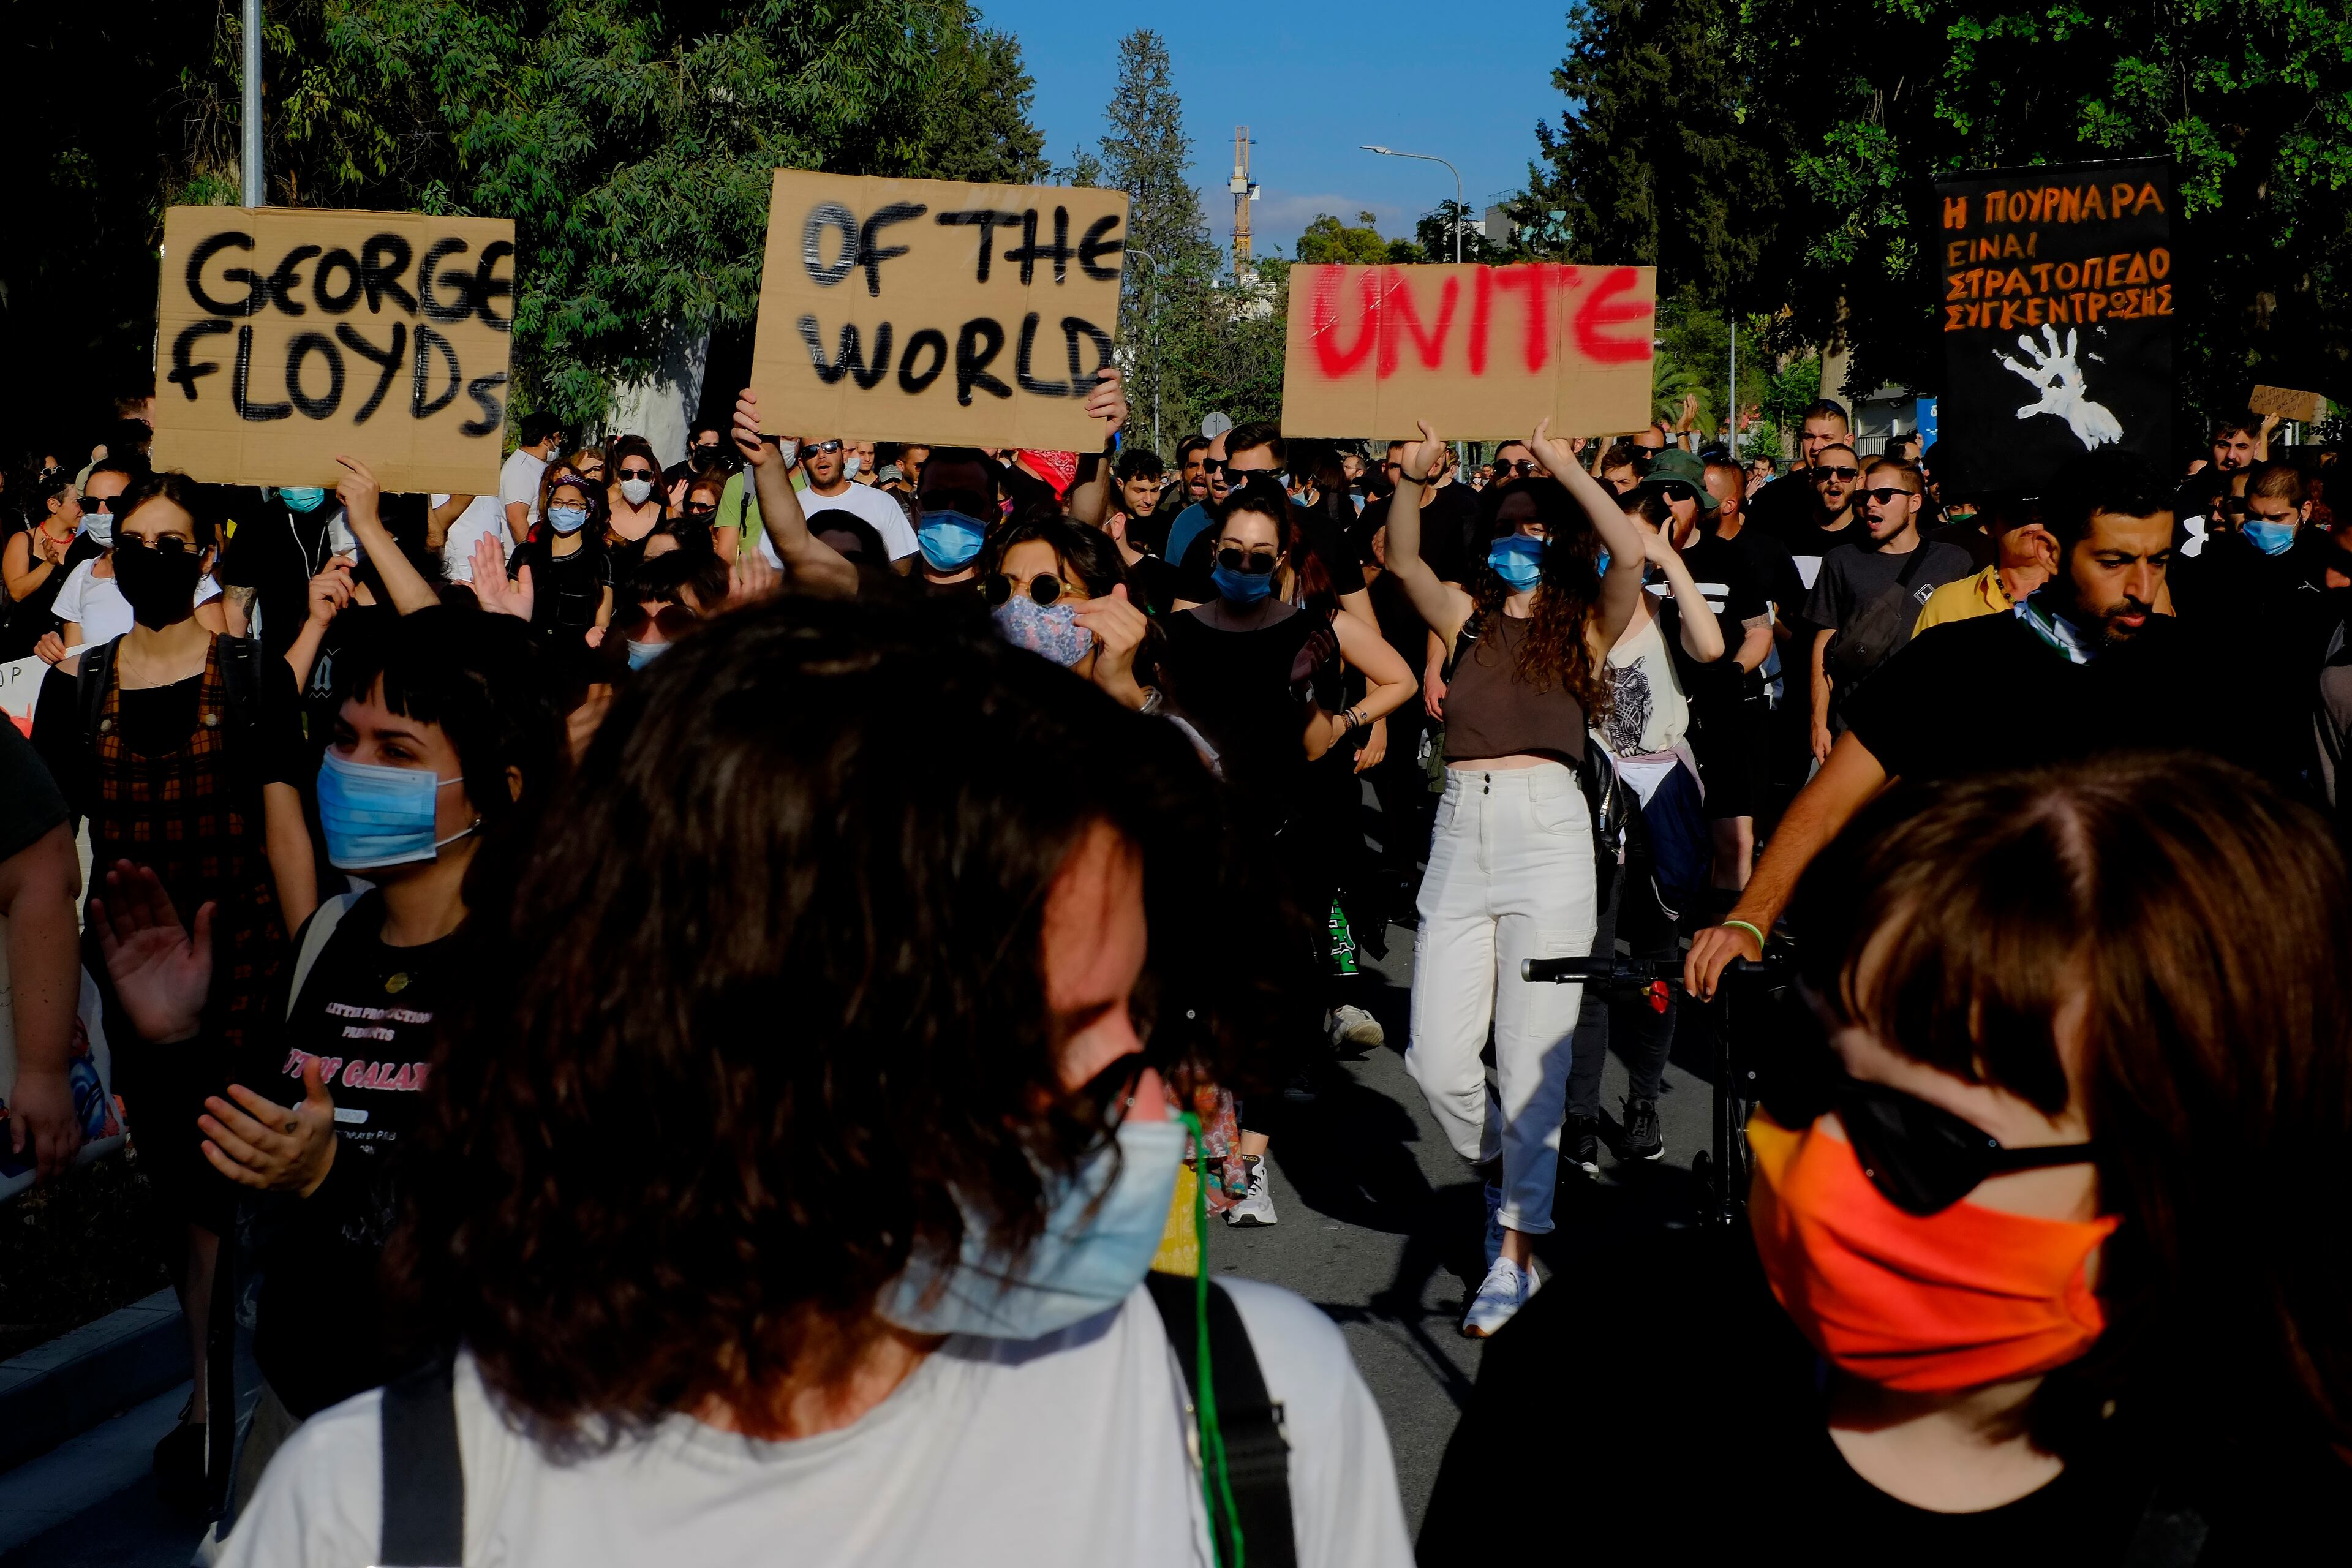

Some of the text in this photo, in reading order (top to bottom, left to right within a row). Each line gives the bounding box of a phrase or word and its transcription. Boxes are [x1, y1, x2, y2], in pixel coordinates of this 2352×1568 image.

[1943, 182, 2165, 229] Η ΠΟΥΡΝΑΡΑ
[186, 231, 514, 332] GEORGE
[802, 201, 1125, 298] OF THE
[1945, 247, 2171, 301] ΣΤΡΑΤΟΠΕΔΟ
[1947, 232, 2038, 268] ΕΙΝΑΙ
[1310, 263, 1653, 379] UNITE
[798, 312, 1114, 407] WORLD
[342, 1060, 430, 1091] GALAX
